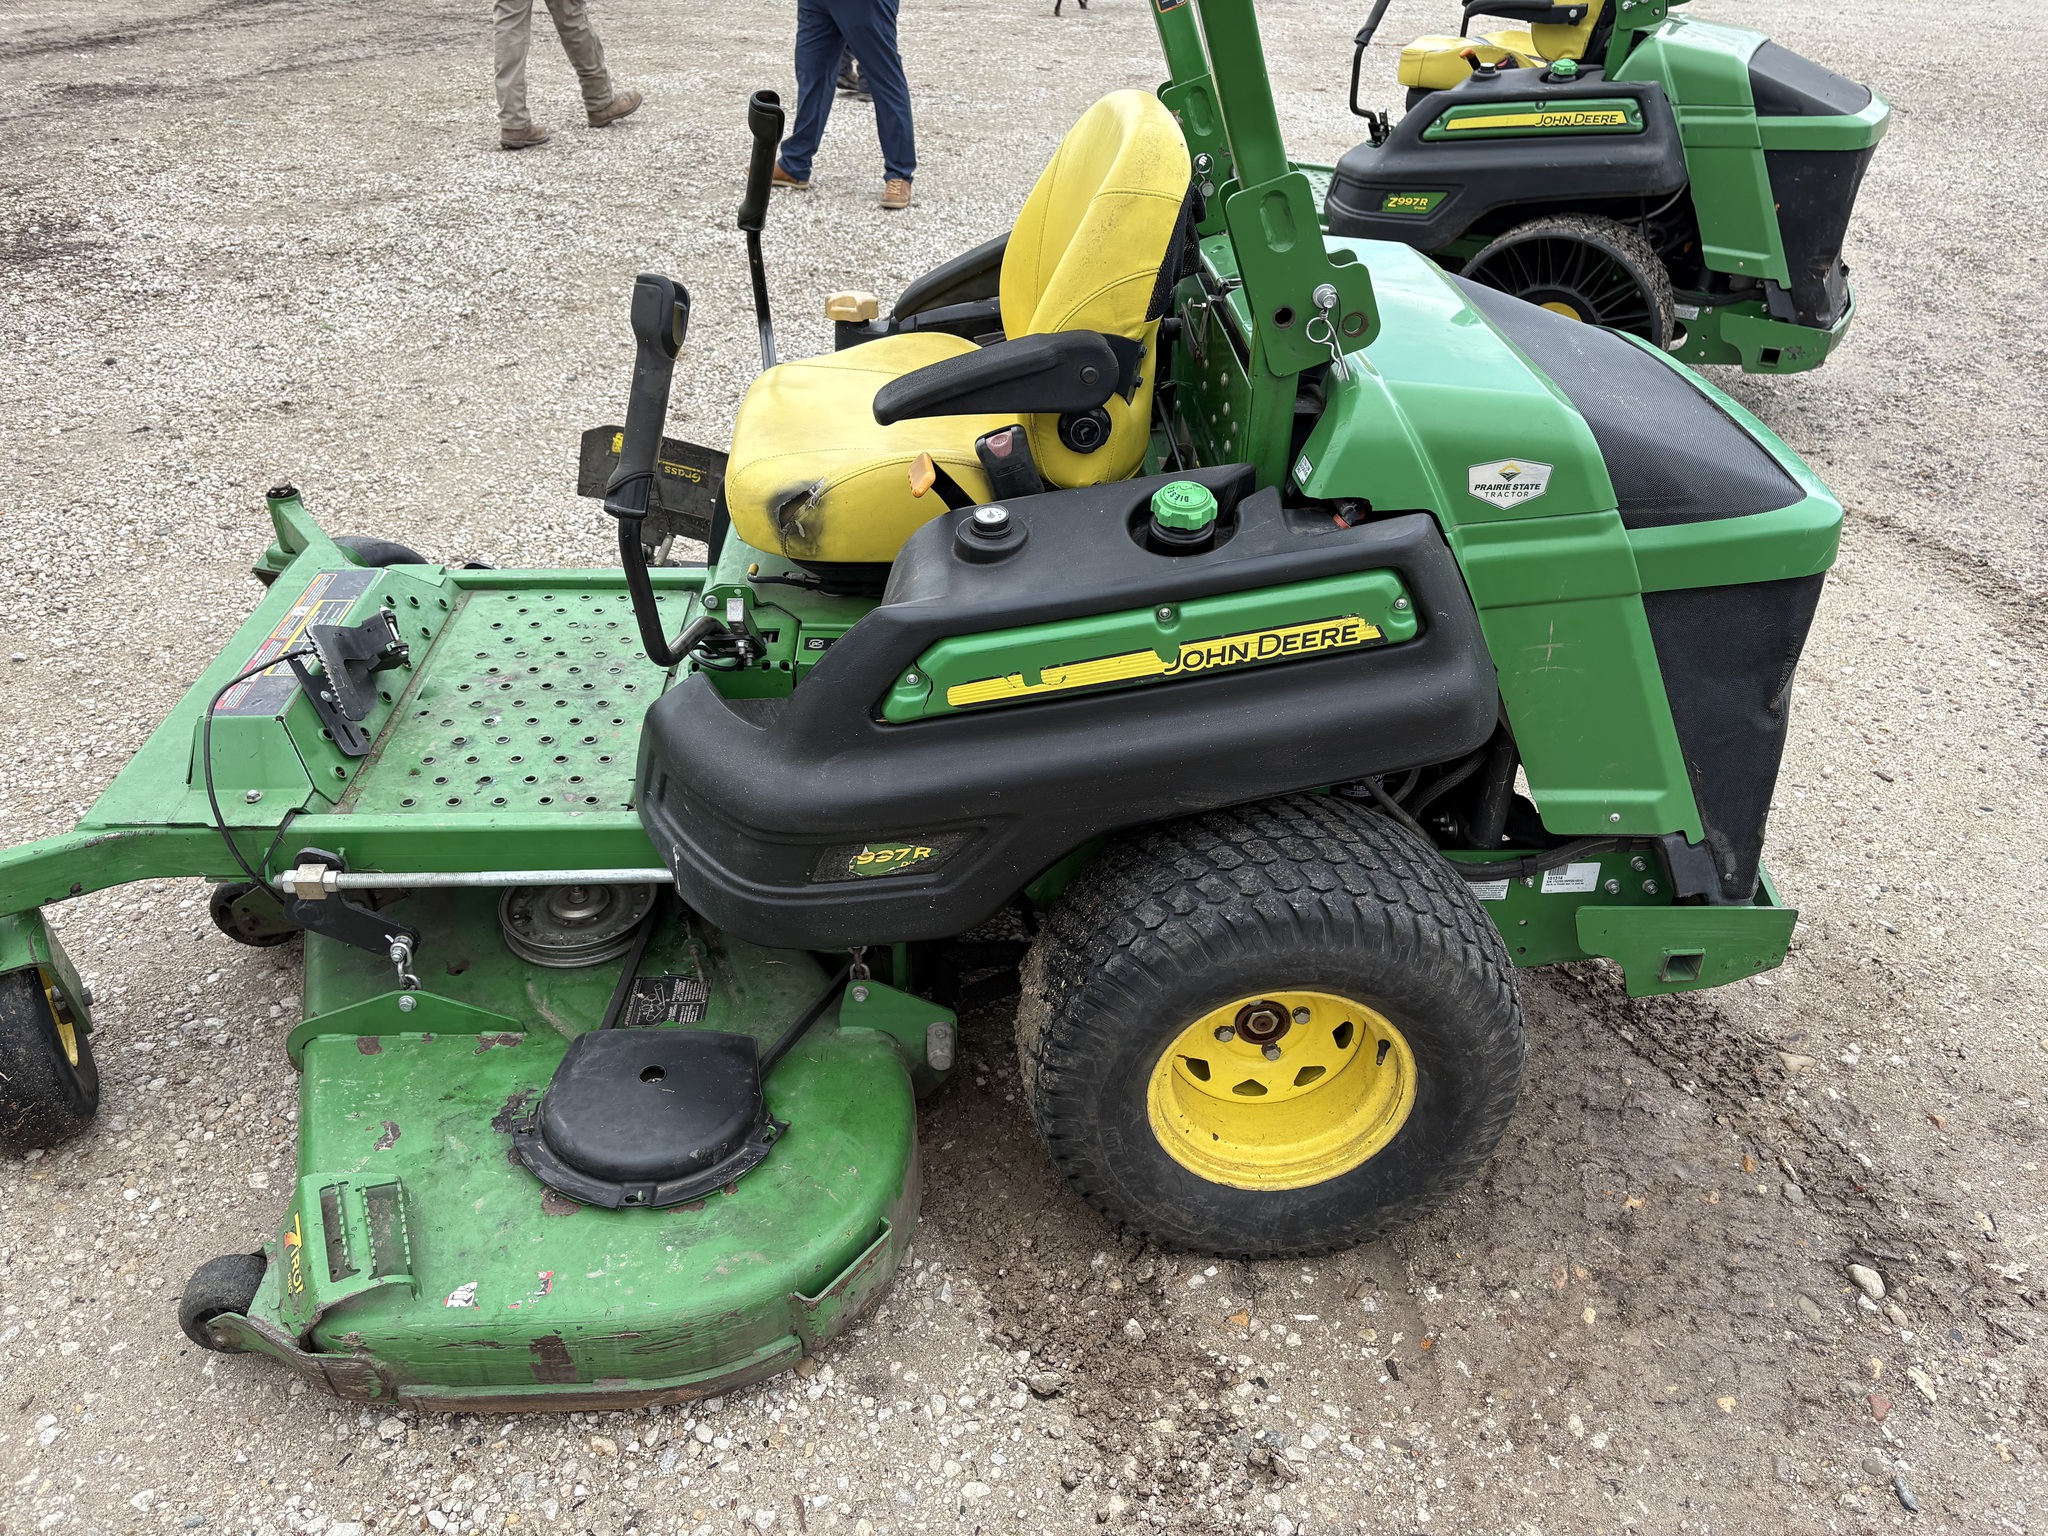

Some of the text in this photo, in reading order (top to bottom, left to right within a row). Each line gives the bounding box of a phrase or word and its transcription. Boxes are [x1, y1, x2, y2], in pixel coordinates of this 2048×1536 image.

[1535, 113, 1618, 125] JOHN DEERE
[1387, 197, 1428, 208] Z997R
[663, 465, 701, 483] Grass
[1167, 485, 1189, 503] DIESEL
[1474, 483, 1541, 491] PRAIRIE STATE
[1164, 623, 1360, 673] JOHN DEERE
[852, 846, 932, 867] 997R
